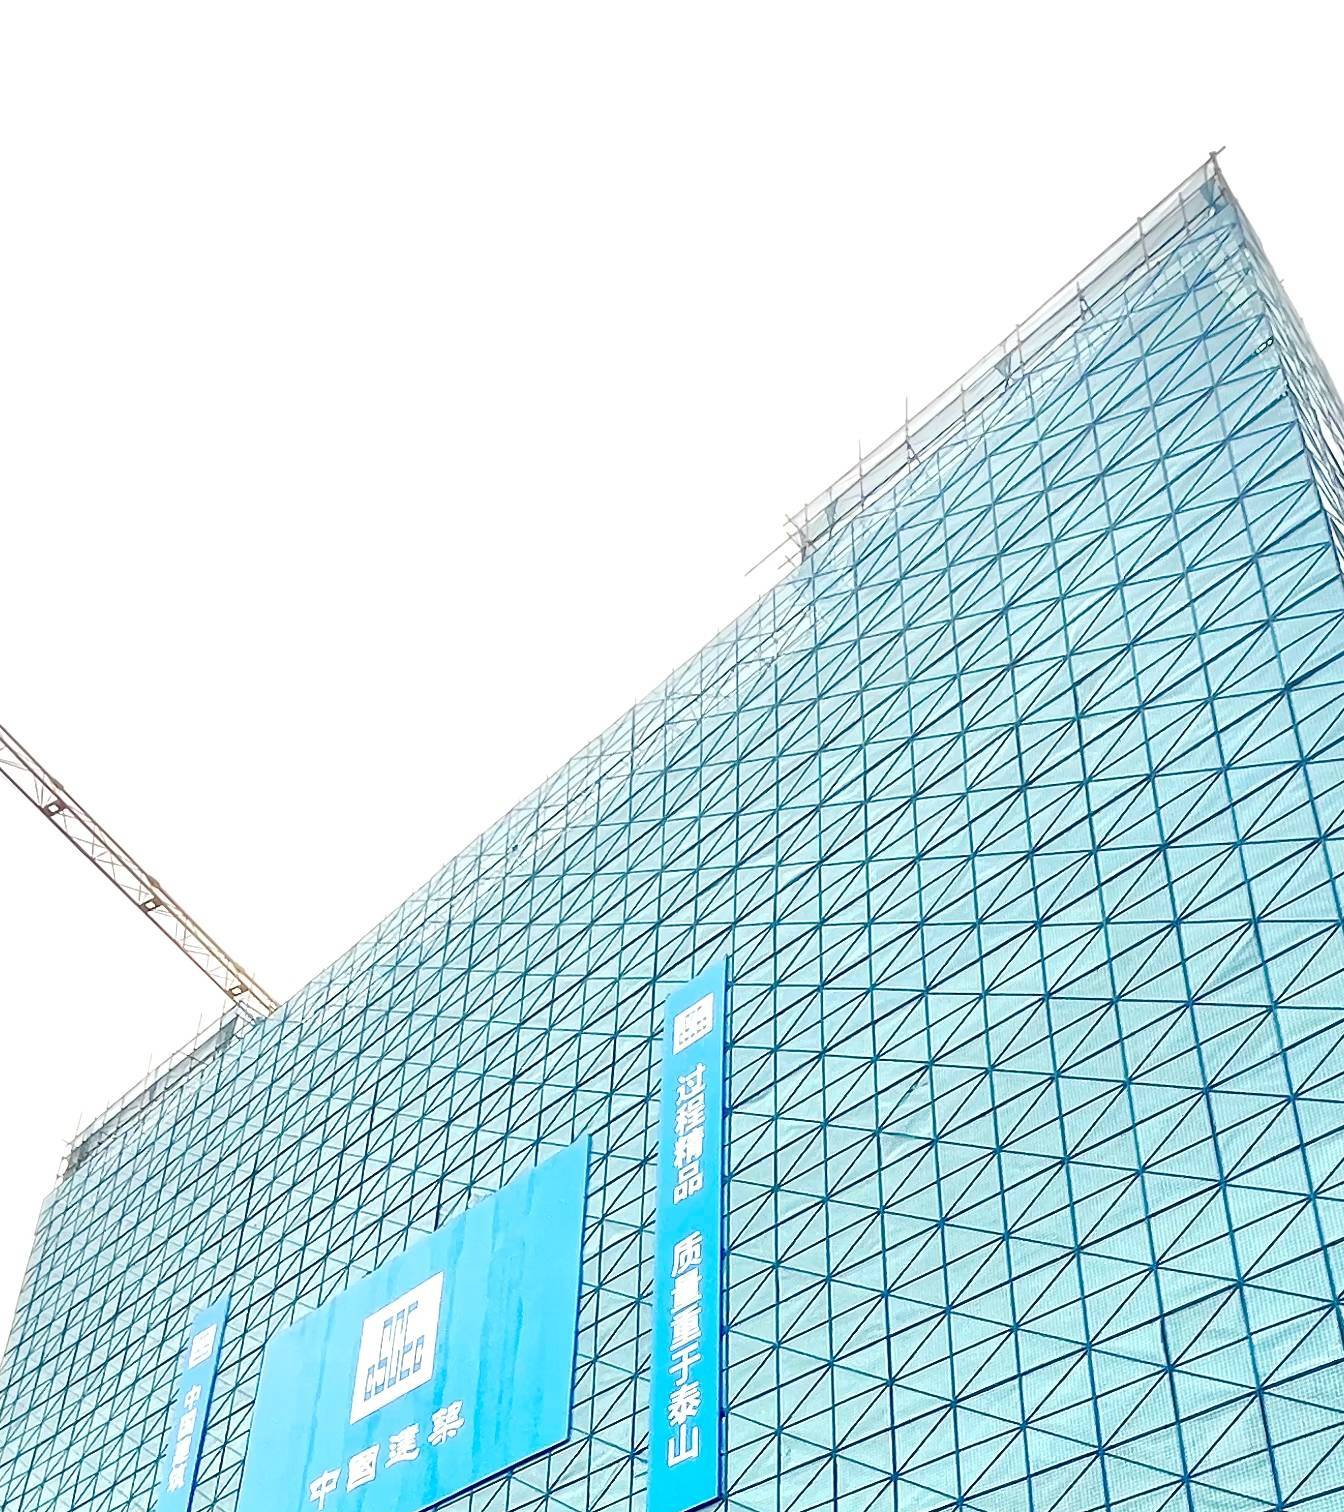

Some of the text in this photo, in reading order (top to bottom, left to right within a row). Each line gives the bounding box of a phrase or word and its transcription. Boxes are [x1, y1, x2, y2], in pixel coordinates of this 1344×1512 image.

[671, 1062, 707, 1206] 过程精品
[665, 1230, 705, 1469] 质量重于泰山
